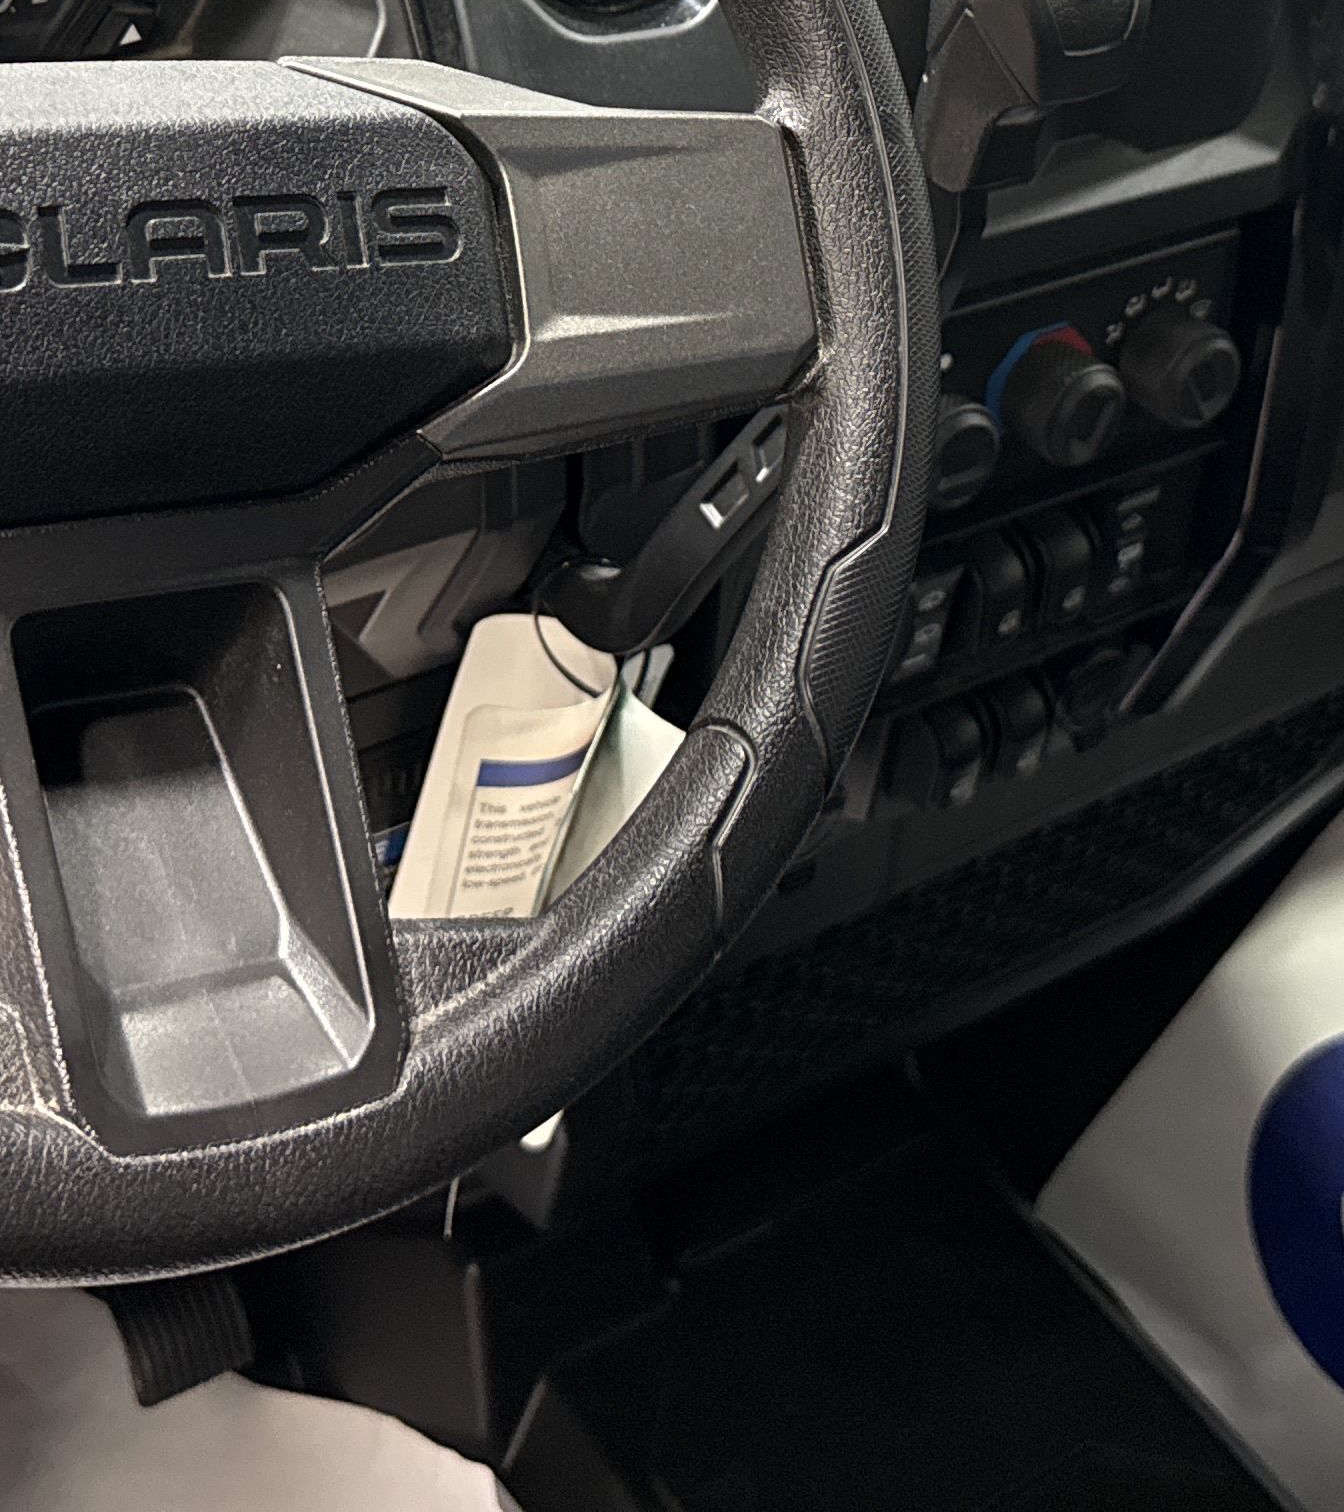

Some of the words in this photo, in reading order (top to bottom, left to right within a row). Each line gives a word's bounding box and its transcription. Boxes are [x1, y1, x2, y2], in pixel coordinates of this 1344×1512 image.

[479, 801, 507, 815] This
[474, 811, 555, 829] transmission
[470, 825, 546, 845] constructed
